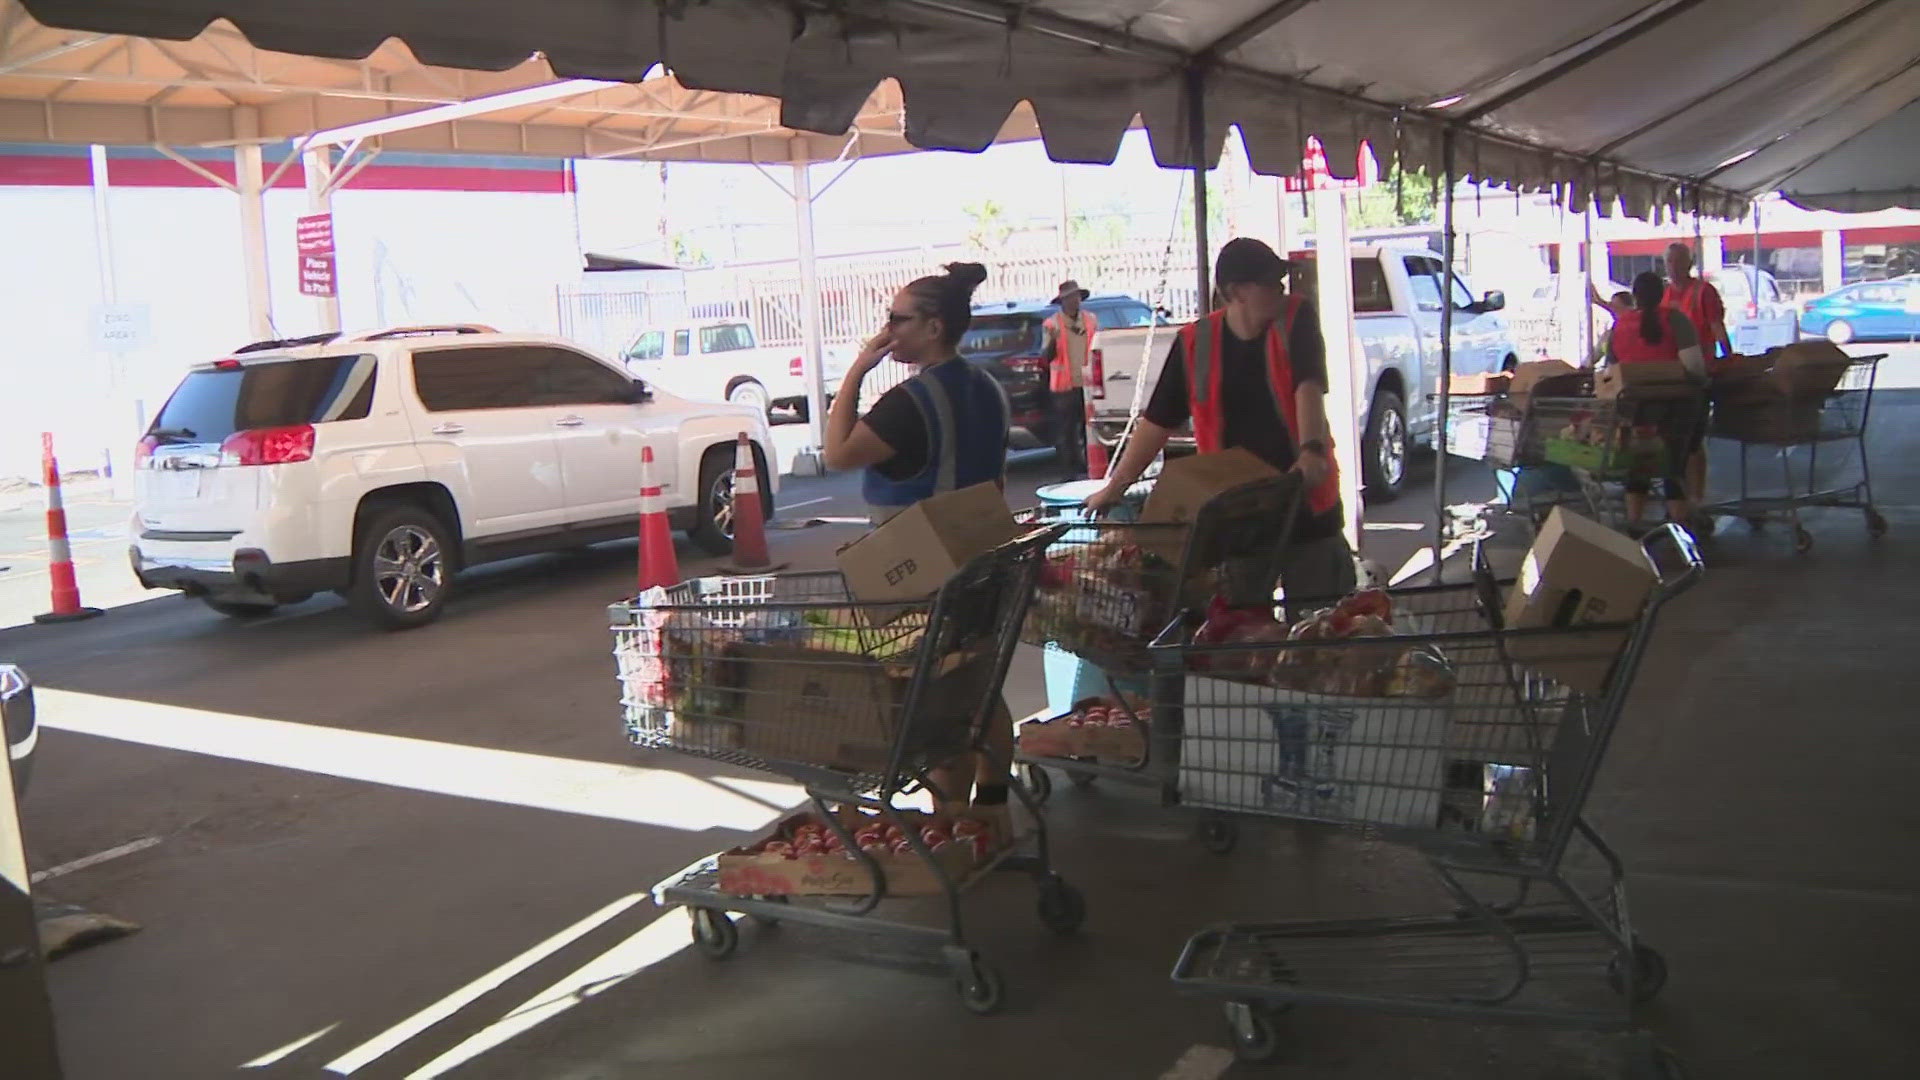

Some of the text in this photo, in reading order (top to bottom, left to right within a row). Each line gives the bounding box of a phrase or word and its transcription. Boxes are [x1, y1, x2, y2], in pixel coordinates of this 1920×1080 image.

[305, 257, 328, 269] Place
[303, 270, 331, 282] Vehicle
[884, 558, 917, 587] EFB
